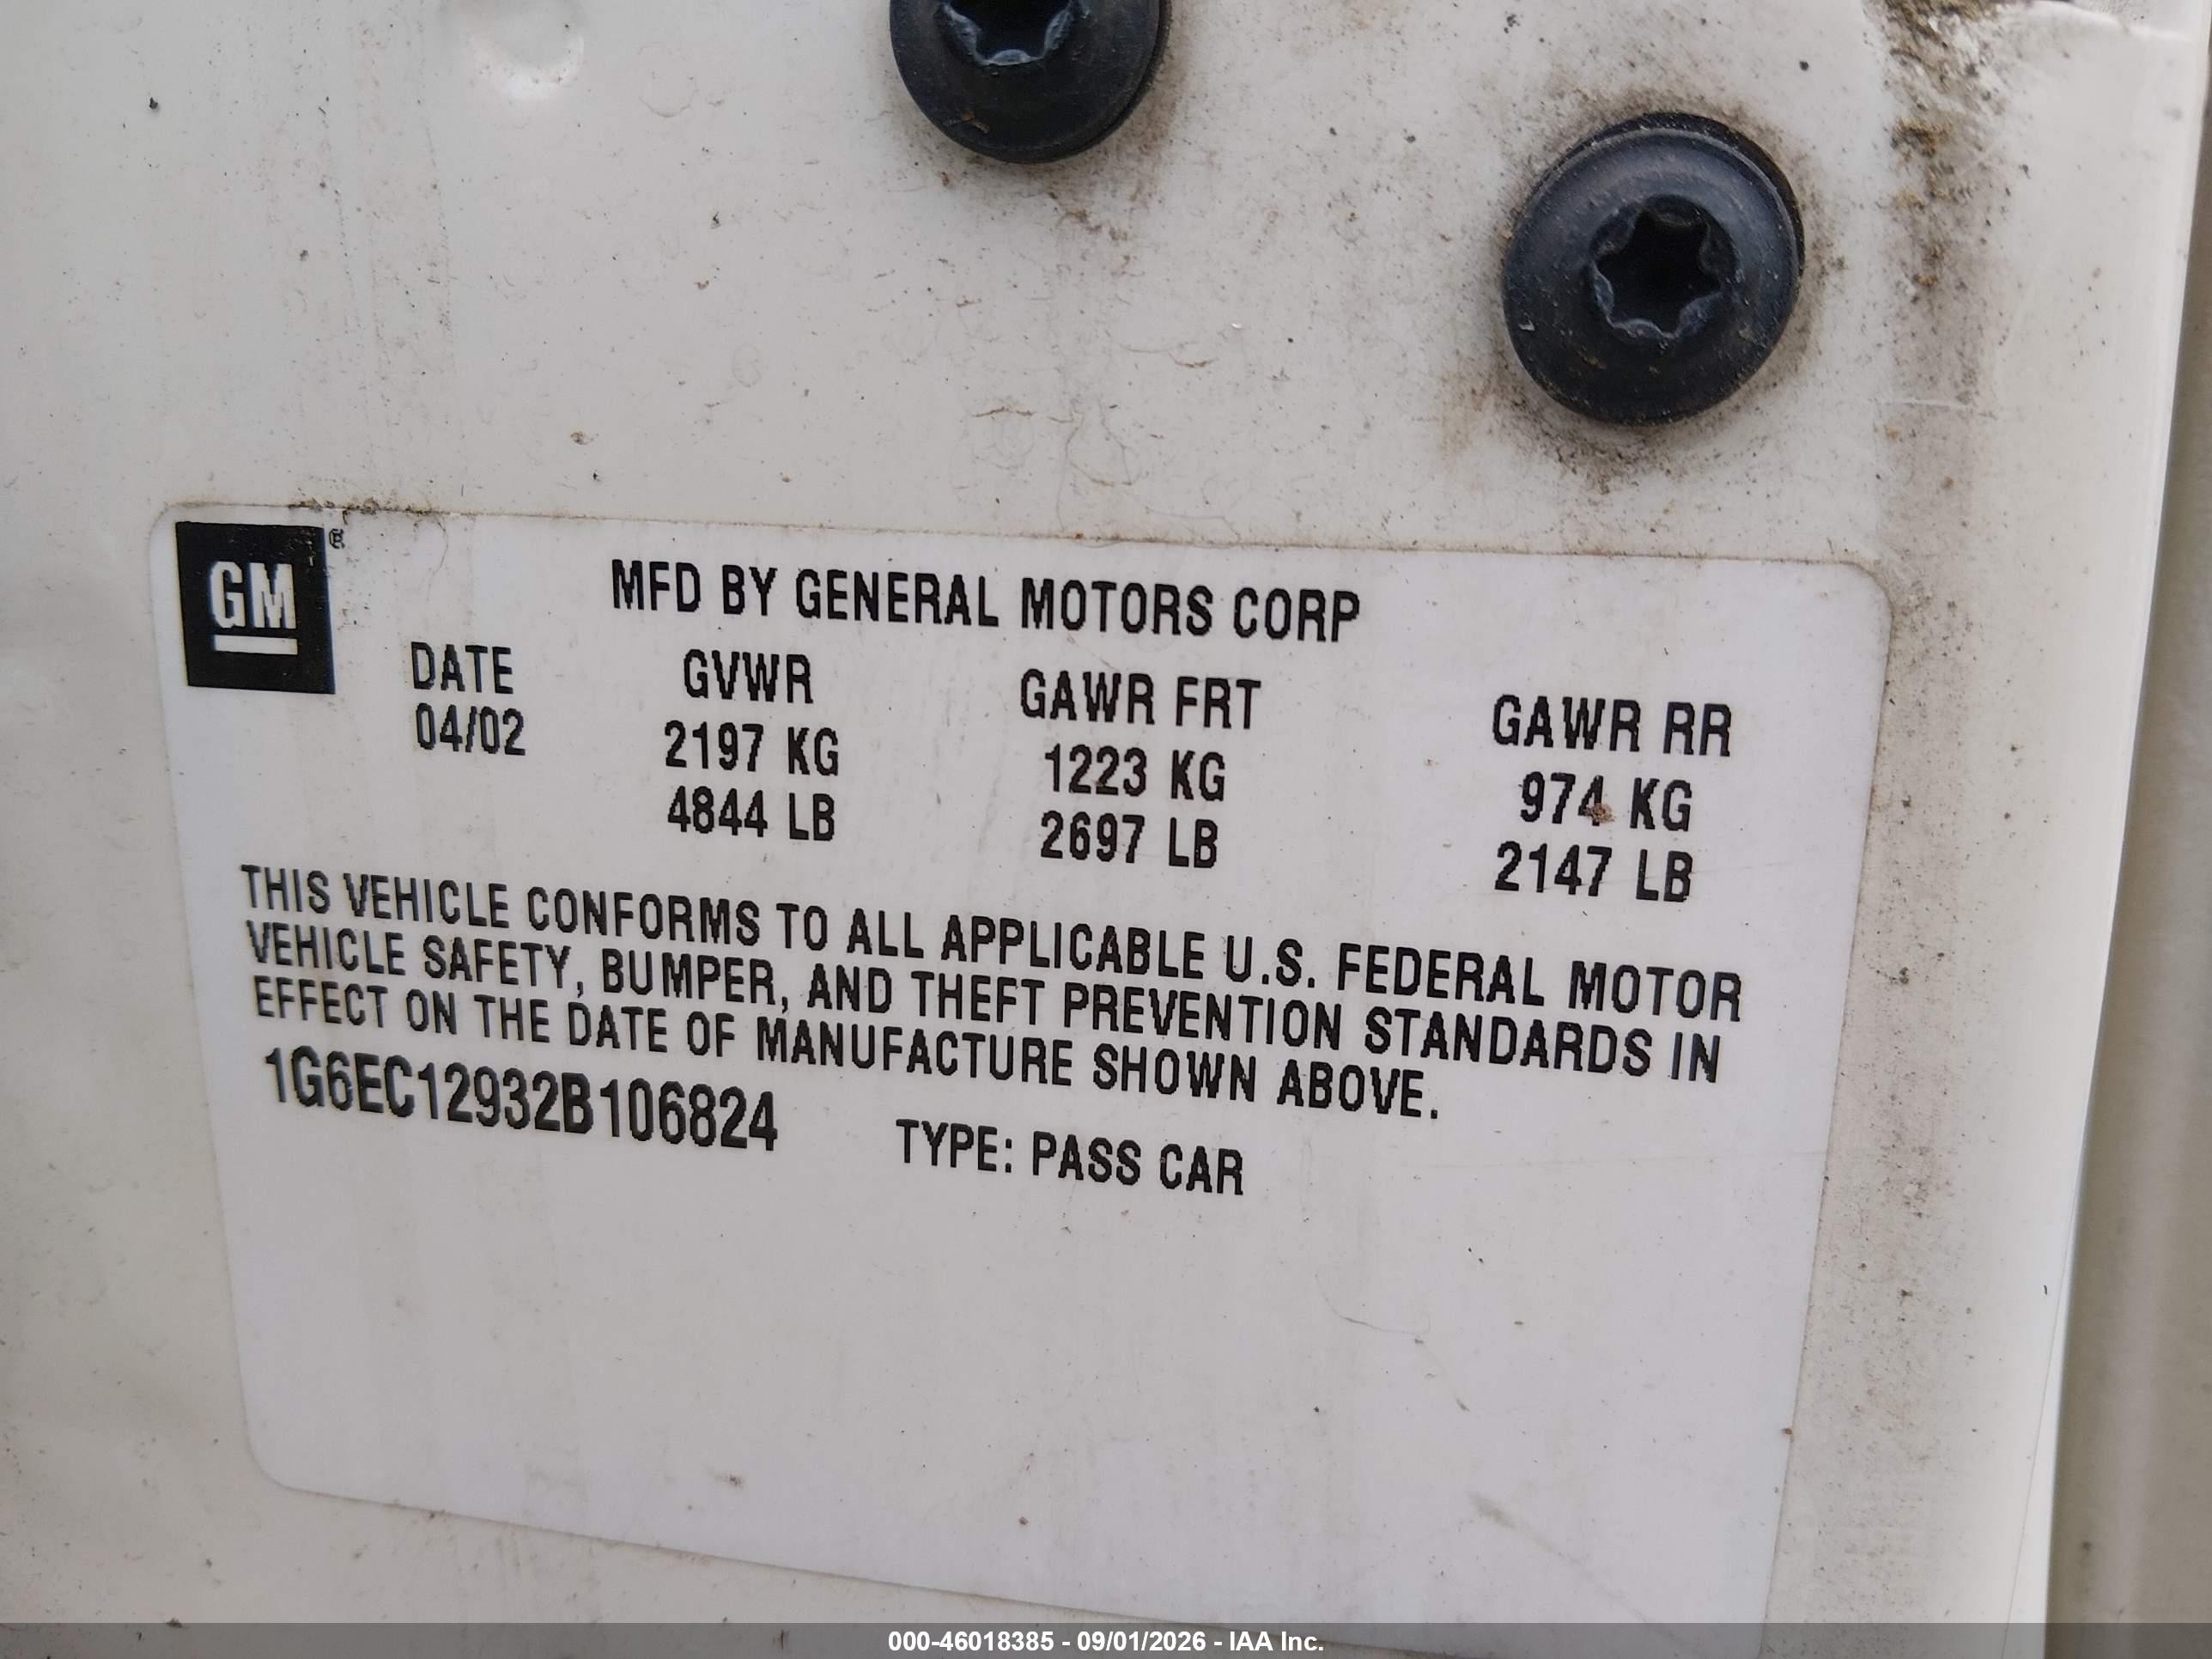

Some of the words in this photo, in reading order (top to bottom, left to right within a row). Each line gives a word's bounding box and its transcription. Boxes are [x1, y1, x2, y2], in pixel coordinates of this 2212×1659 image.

[210, 560, 297, 629] GM
[612, 559, 701, 612] MFD
[722, 564, 777, 616] BY
[796, 569, 999, 627] GENERAL
[1022, 578, 1212, 636] MOTORS
[1234, 587, 1359, 642] CORP
[411, 641, 513, 694] DATE
[684, 649, 813, 703] GVWR
[416, 702, 525, 756] 04/02
[1021, 669, 1155, 725] GAWR
[1176, 676, 1261, 729] FRT
[1492, 695, 1641, 752] GAWR
[1663, 702, 1731, 757] RR
[665, 720, 763, 772] 2197
[788, 726, 838, 776] KG
[1045, 744, 1146, 797] 1223
[1171, 750, 1224, 801] KG
[668, 786, 768, 837] 4844
[789, 793, 835, 842] LB
[1518, 772, 1612, 826] 974
[1630, 778, 1692, 831] KG
[1041, 811, 1145, 863] 2697
[1169, 817, 1218, 868] LB
[1495, 841, 1612, 896] 2147
[1636, 849, 1692, 902] LB
[241, 865, 330, 914] THIS
[343, 873, 509, 928] VEHICLE
[527, 887, 759, 946] CONFORMS
[776, 903, 827, 951] TO
[847, 908, 924, 958] ALL
[941, 915, 1205, 979] APPLICABLE
[1226, 935, 1315, 988] U.S.
[1338, 943, 1544, 1006] FEDERAL
[1569, 961, 1741, 1022] MOTOR
[246, 920, 405, 975] VEHICLE
[423, 935, 584, 999] SAFETY,
[602, 948, 788, 1014] BUMPER,
[807, 963, 891, 1013] AND
[911, 971, 1045, 1025] THEFT
[1064, 982, 1341, 1050] PREVENTION
[1364, 1006, 1652, 1077] STANDARDS
[1671, 1032, 1720, 1083] IN
[254, 975, 388, 1028] EFFECT
[406, 989, 457, 1035] ON
[474, 994, 550, 1042] THE
[568, 1002, 667, 1053] DATE
[687, 1012, 735, 1057] OF
[757, 1017, 1073, 1086] MANUFACTURE
[1093, 1043, 1255, 1102] SHOWN
[1277, 1059, 1437, 1119] ABOVE.
[265, 1046, 777, 1151] 1G6EC12932B106824
[896, 1119, 1012, 1173] TYPE:
[1033, 1131, 1140, 1186] PASS
[1160, 1144, 1243, 1195] CAR
